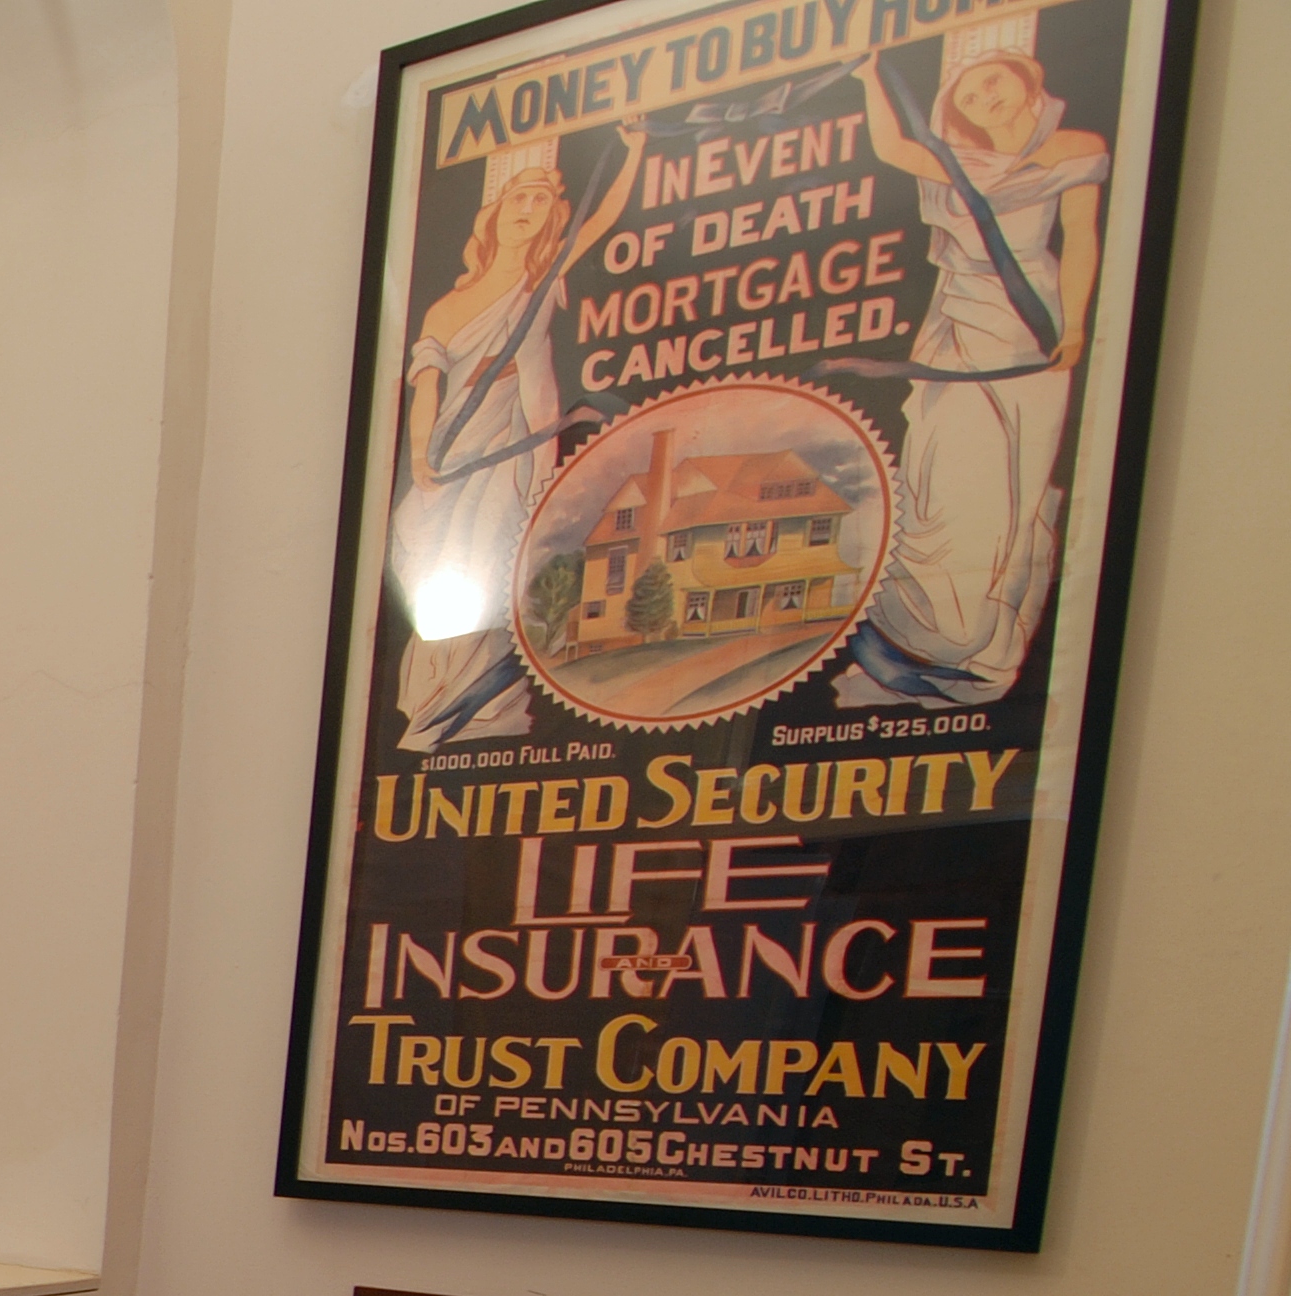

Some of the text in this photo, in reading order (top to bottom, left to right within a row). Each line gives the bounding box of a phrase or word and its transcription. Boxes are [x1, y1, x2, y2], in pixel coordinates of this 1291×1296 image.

[446, 48, 657, 163] MONEY
[668, 26, 732, 91] TO
[740, 0, 858, 72] BUY
[641, 112, 865, 211] IN EVENT
[604, 176, 875, 275] OF DEATH
[577, 230, 904, 344] MORTGAGE
[580, 296, 911, 392] CANCELLED.
[520, 746, 561, 765] FULL
[568, 741, 616, 761] PAID.
[772, 723, 863, 746] SURPLUS
[373, 748, 1021, 843] UNITED SECURITY
[513, 834, 831, 926] LIFE
[363, 917, 988, 1010] INSURANCE
[617, 956, 674, 970] AND
[348, 1012, 987, 1100] TRUST COMPANY
[416, 1122, 494, 1157] 603
[494, 1135, 566, 1160] AND
[569, 1128, 655, 1164] 605
[657, 1131, 879, 1173] CHESTNUT
[899, 1140, 972, 1178] ST.
[435, 1094, 839, 1129] OF PENNSYLVANIA
